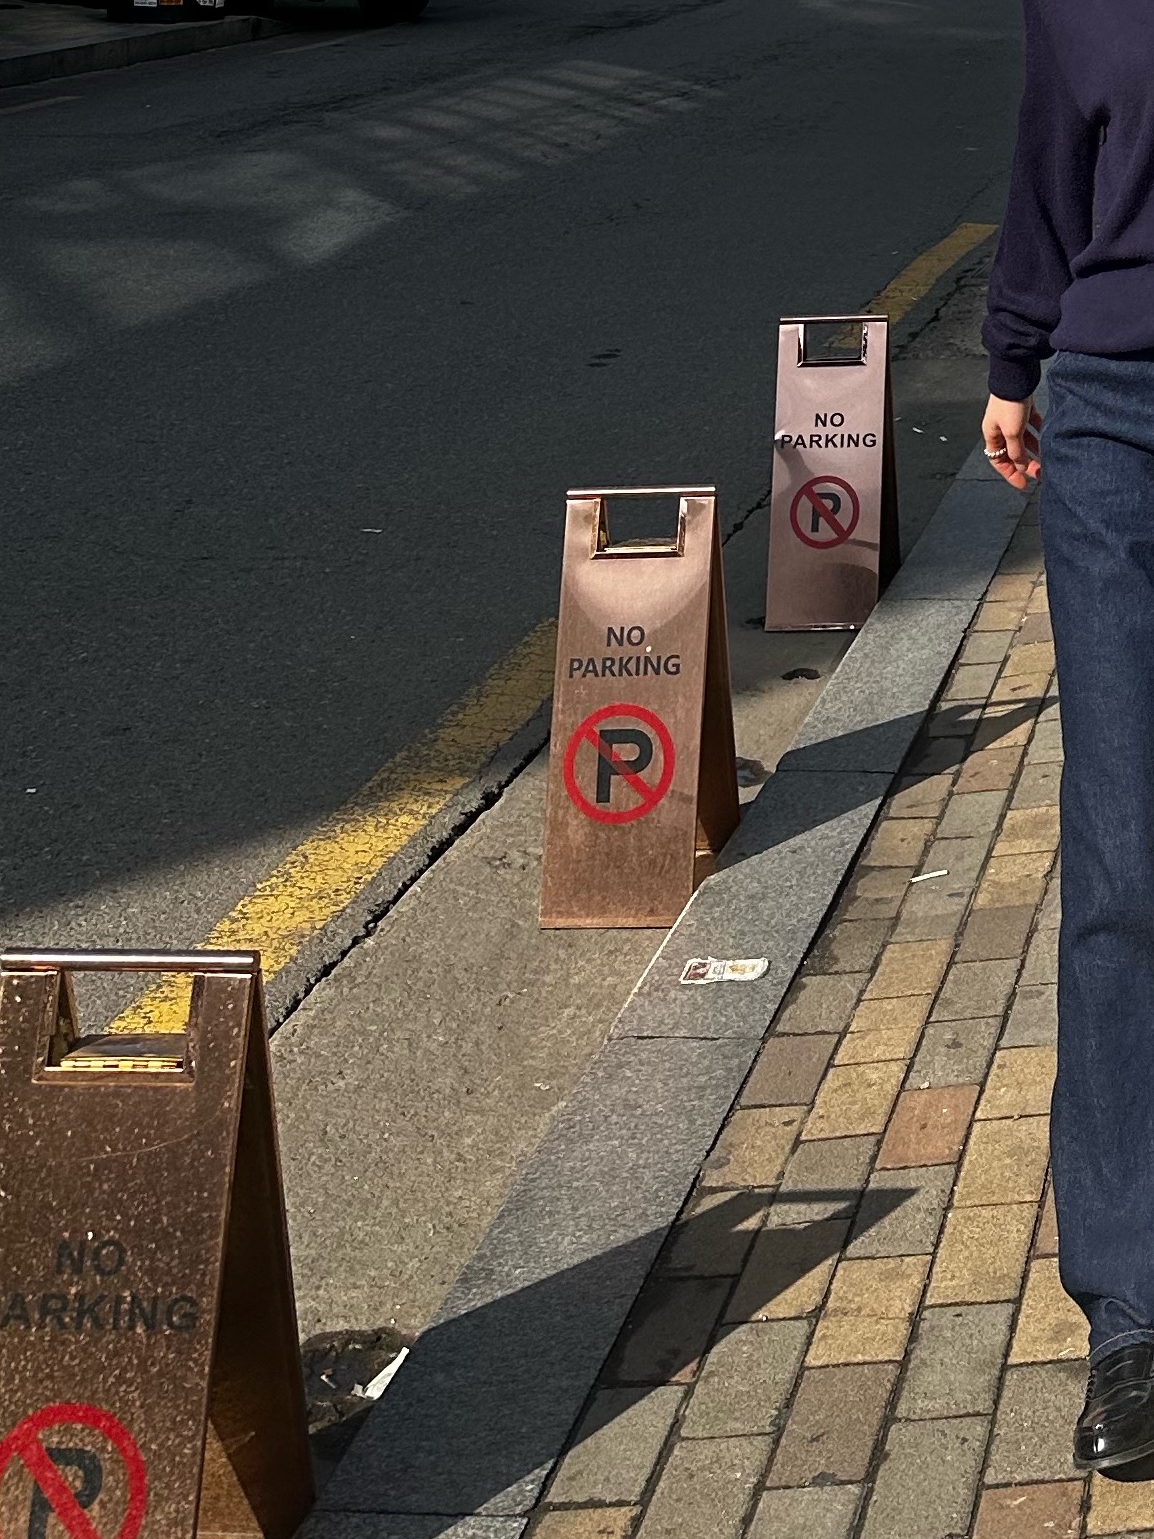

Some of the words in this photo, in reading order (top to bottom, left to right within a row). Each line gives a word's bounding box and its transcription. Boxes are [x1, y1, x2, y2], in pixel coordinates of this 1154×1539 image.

[814, 412, 845, 428] NO
[780, 433, 877, 448] PARKING
[606, 626, 646, 647] NO
[569, 654, 681, 679] PARKING
[55, 1239, 127, 1276] NO
[0, 1292, 200, 1331] ARKING
